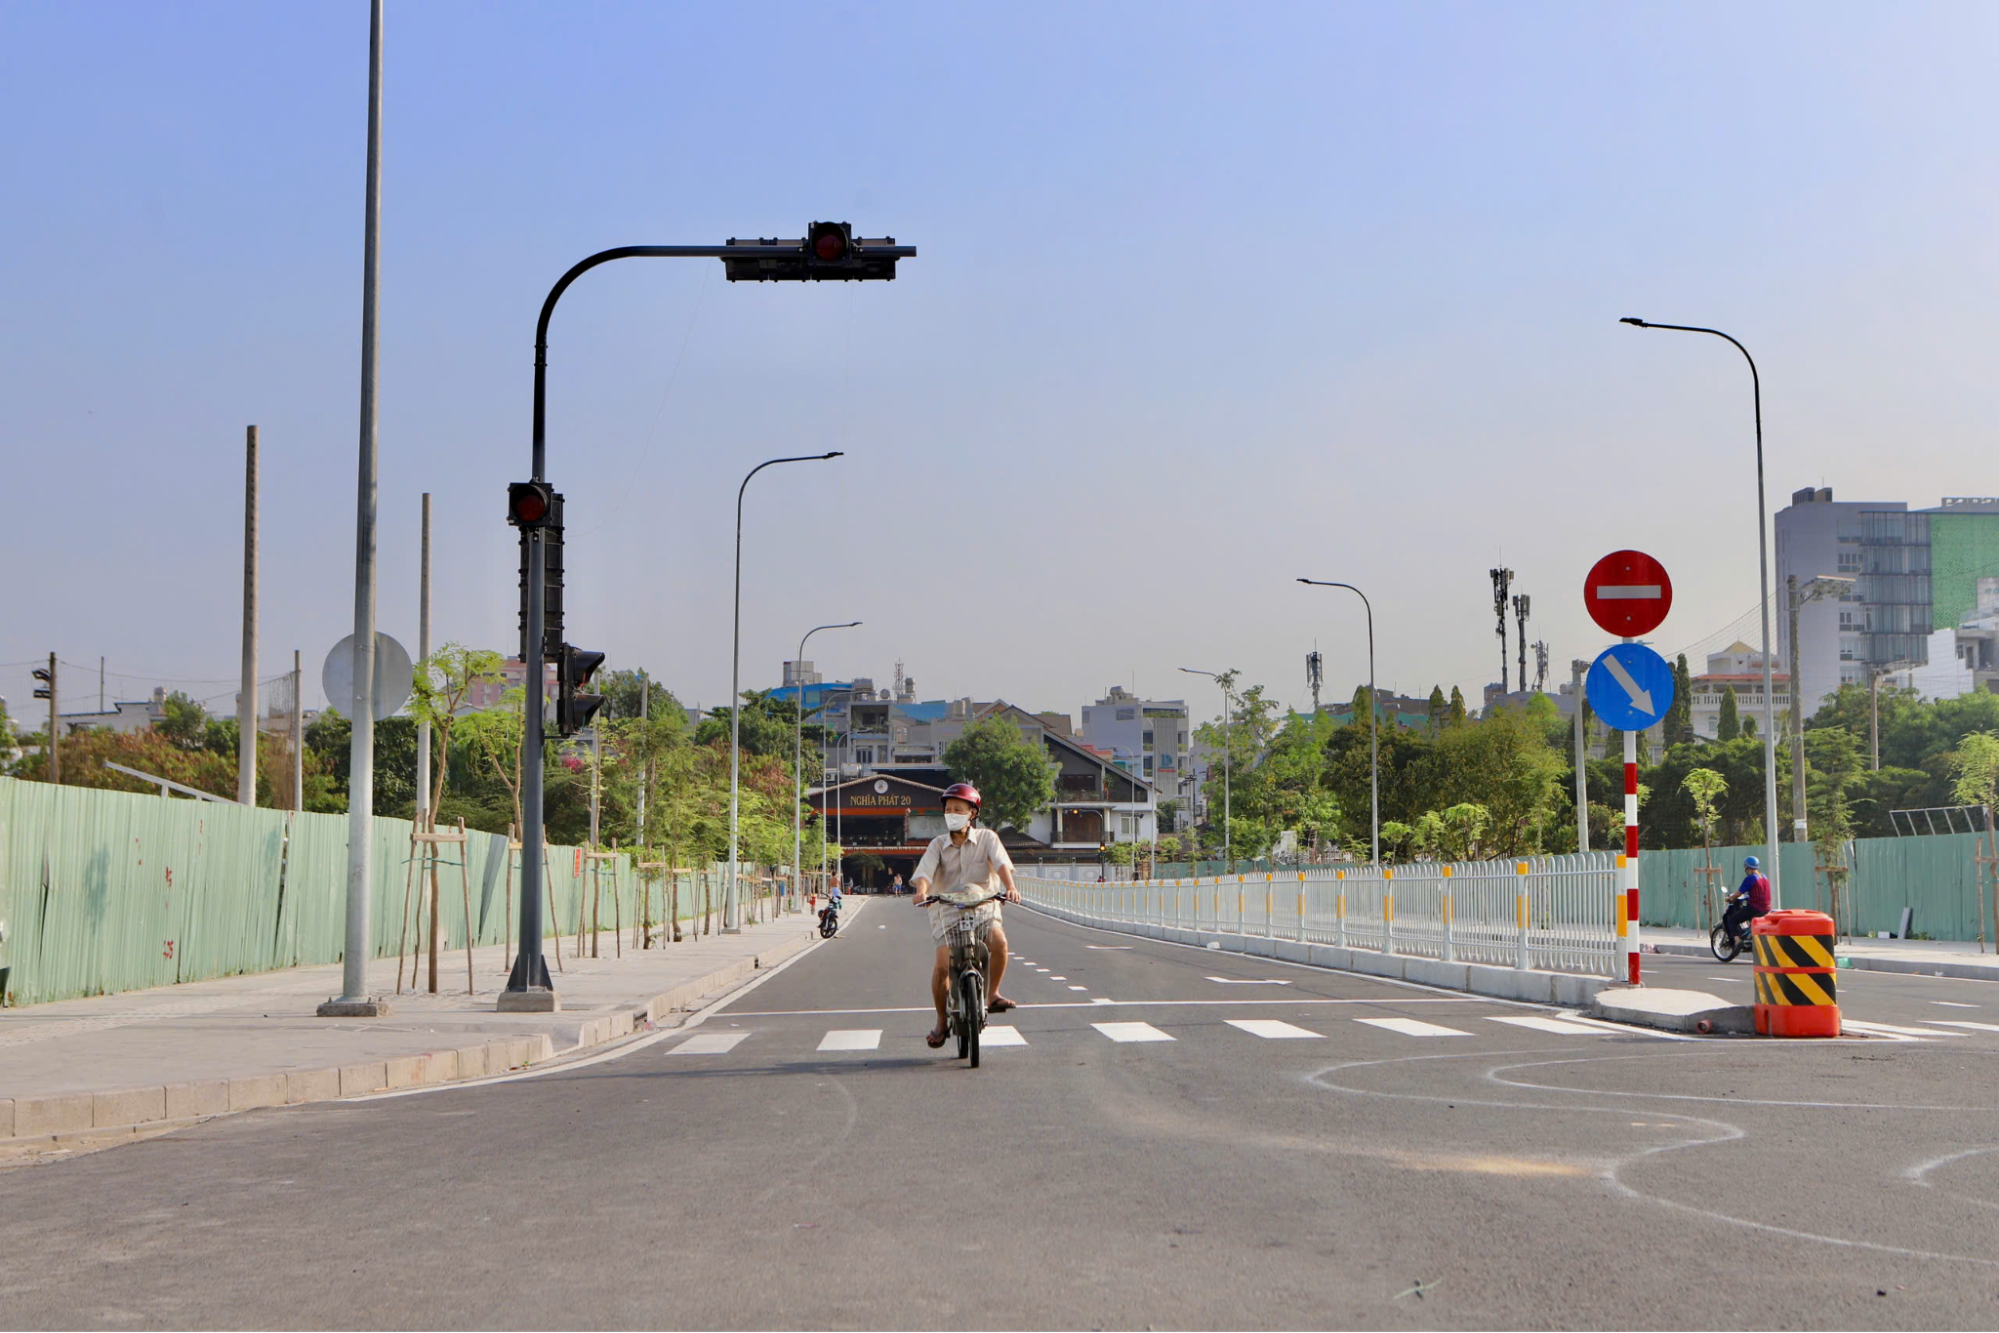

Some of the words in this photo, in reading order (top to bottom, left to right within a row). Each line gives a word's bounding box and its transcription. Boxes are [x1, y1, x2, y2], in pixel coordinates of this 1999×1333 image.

[851, 794, 876, 806] NGHĨA
[878, 794, 899, 806] PHÁT
[901, 795, 911, 806] 20
